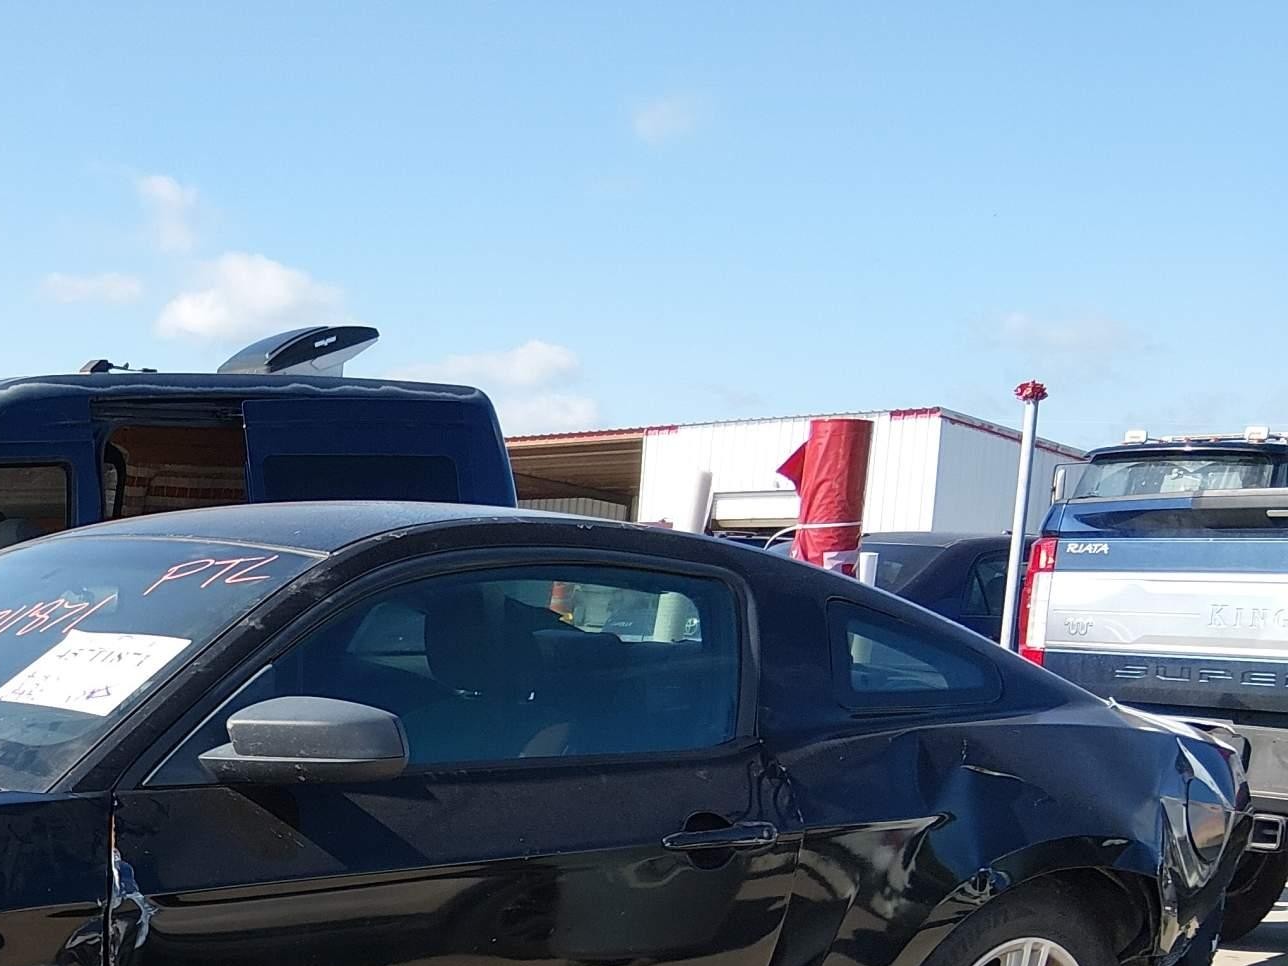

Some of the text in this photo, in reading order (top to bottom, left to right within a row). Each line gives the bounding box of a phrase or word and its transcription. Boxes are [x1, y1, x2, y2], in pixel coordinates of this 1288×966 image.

[1066, 543, 1110, 555] RIATA
[143, 554, 279, 596] PTL
[1114, 664, 1288, 687] SUPE
